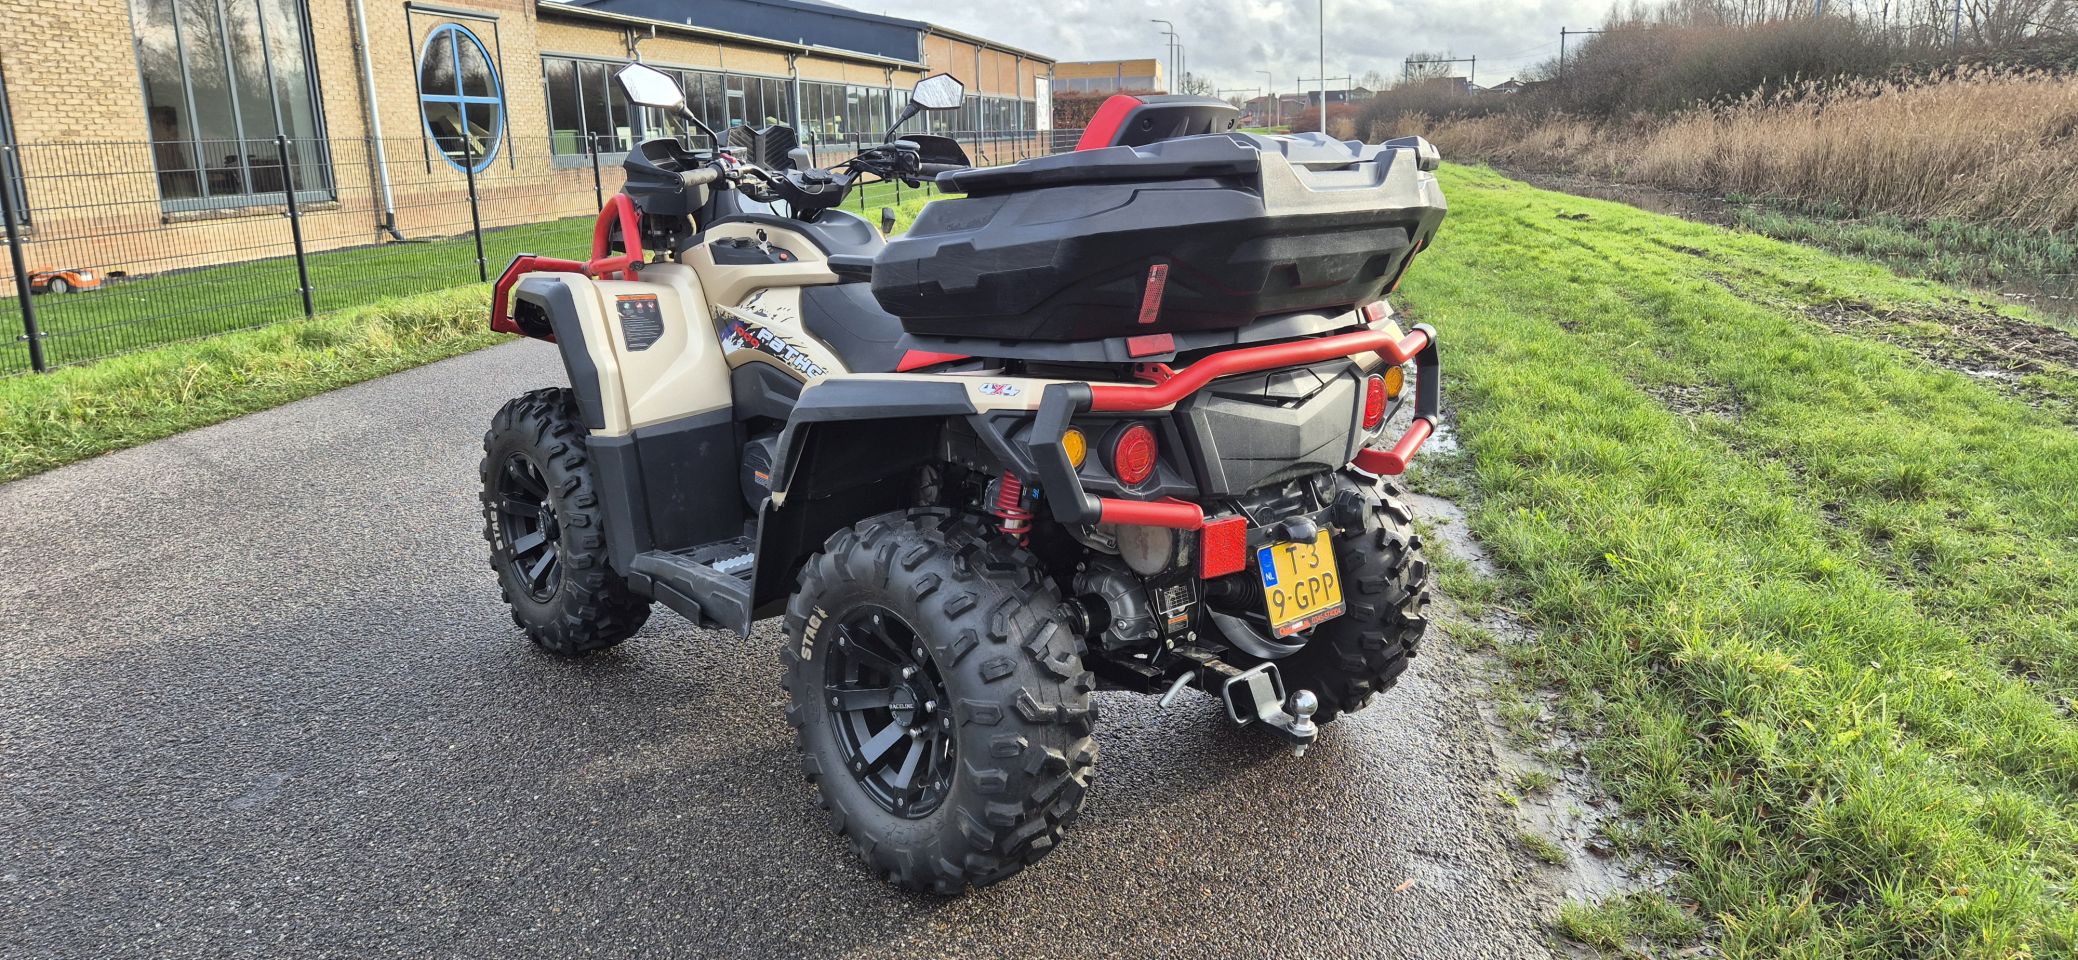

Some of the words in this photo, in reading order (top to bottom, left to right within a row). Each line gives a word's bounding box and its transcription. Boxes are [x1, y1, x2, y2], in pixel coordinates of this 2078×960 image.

[490, 511, 503, 550] STAG
[1265, 572, 1275, 581] NL
[1285, 543, 1320, 575] T-3
[1272, 572, 1334, 619] 9-GPP
[801, 614, 822, 661] STAG
